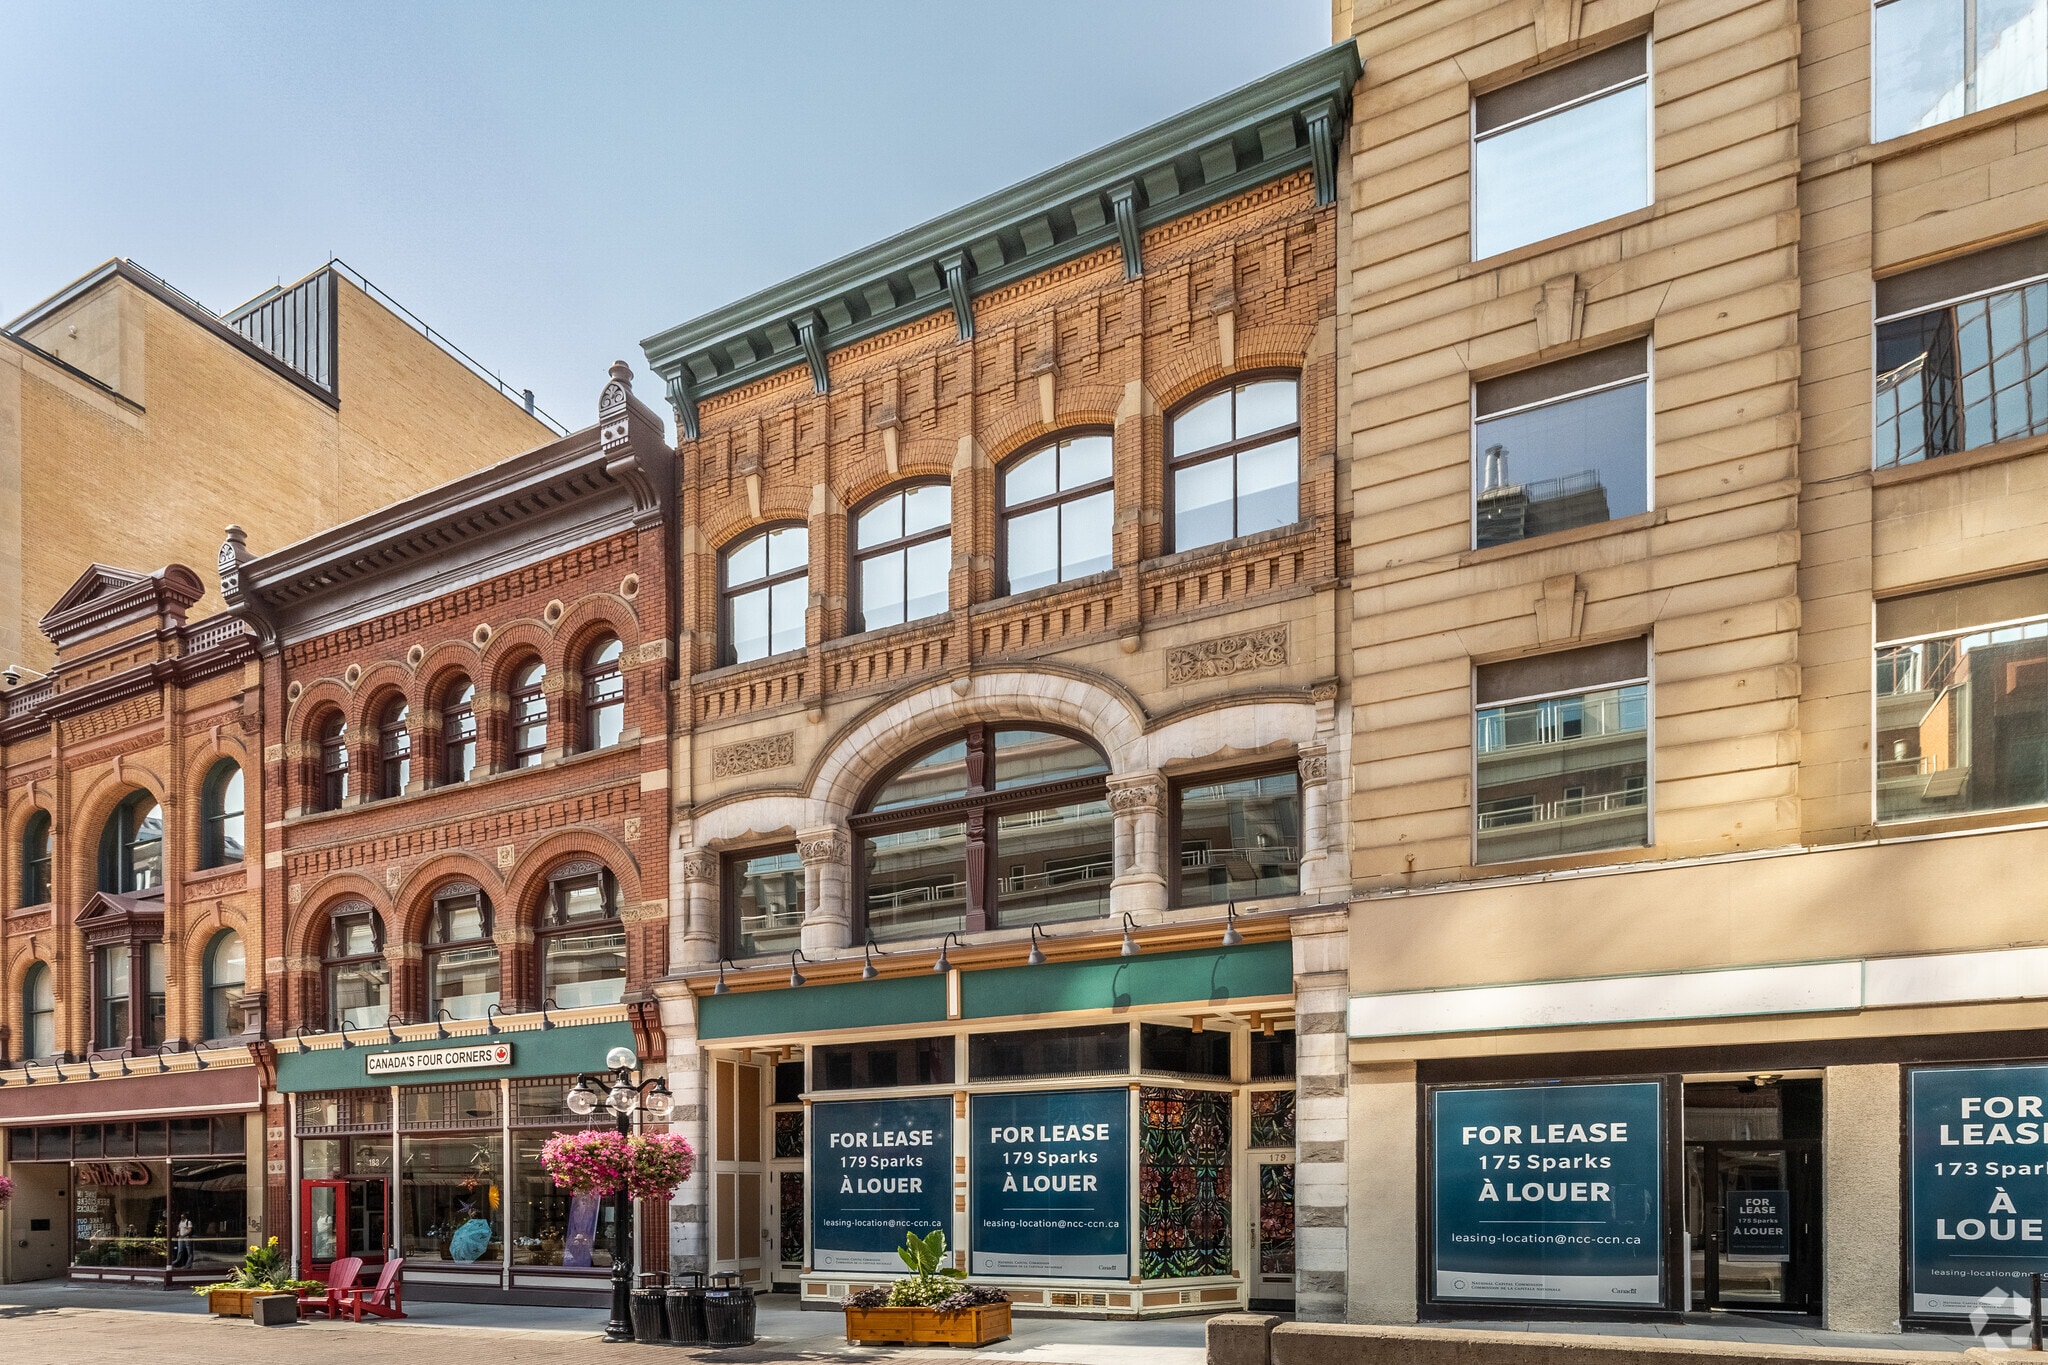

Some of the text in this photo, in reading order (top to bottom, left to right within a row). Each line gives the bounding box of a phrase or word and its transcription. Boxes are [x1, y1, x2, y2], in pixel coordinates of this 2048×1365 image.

[369, 1049, 492, 1070] CANADA'S FOUR CORNERS
[1961, 1096, 2044, 1119] FOR
[830, 1130, 933, 1148] FOR LEASE
[991, 1123, 1110, 1144] FOR LEASE
[1462, 1122, 1628, 1146] FOR LEASE
[1940, 1122, 2048, 1146] LEAS
[840, 1154, 924, 1170] 179 Sparks
[1002, 1150, 1098, 1166] 179 Sparks
[1270, 1154, 1286, 1162] 179
[1478, 1153, 1612, 1172] 175 Sparks
[1934, 1161, 2048, 1178] 173 Spar
[840, 1174, 923, 1194] À LOUER
[1002, 1172, 1098, 1192] À LOUER
[1478, 1178, 1612, 1202] À LOUER
[1988, 1186, 2017, 1214] À
[823, 1219, 942, 1228] leasing-location@ncc-ccn.ca
[983, 1219, 1119, 1229] leasing-location@ncc-ccn.ca
[1733, 1226, 1742, 1235] À
[1451, 1233, 1641, 1244] leasing-location@ncc-ccn.ca
